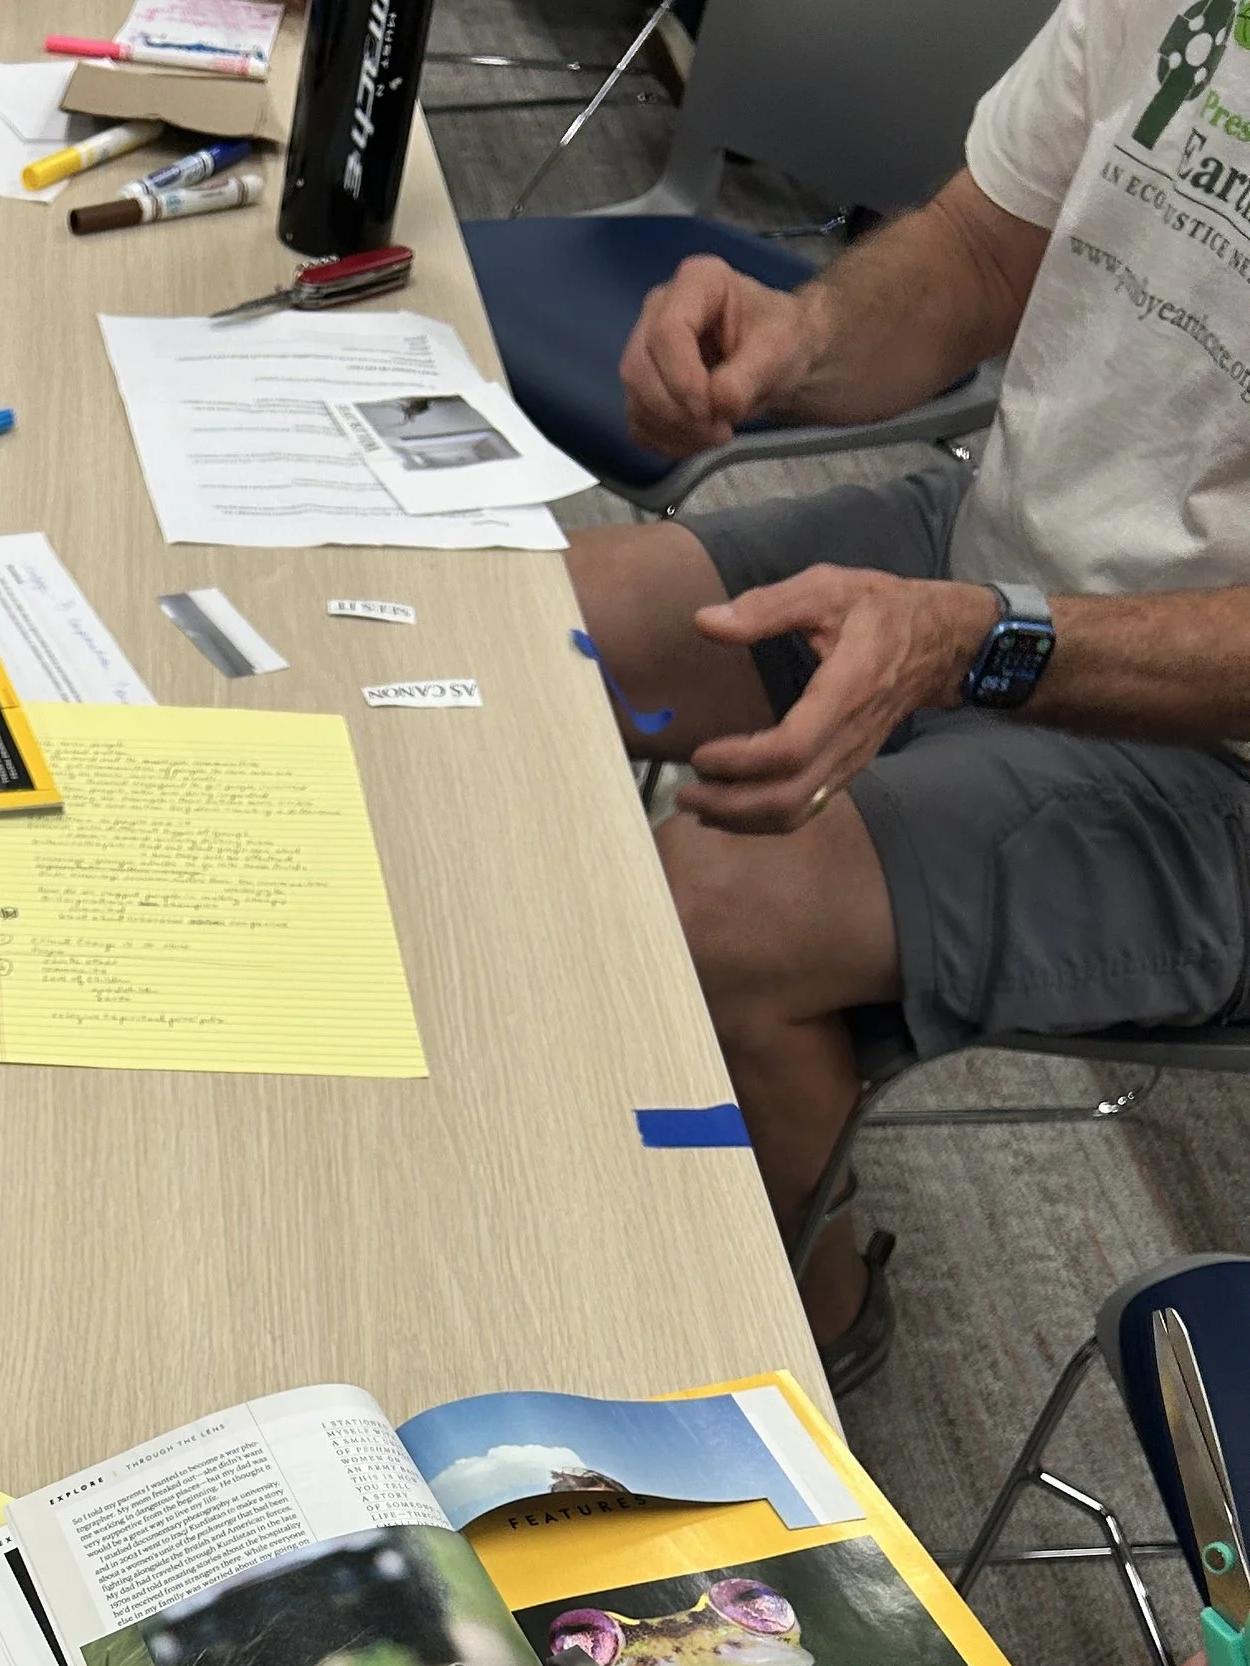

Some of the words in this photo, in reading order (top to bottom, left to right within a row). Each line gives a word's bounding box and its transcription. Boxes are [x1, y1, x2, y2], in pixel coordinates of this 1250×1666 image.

[1177, 127, 1250, 223] Eart
[368, 684, 447, 700] CANON
[449, 683, 478, 698] AS
[126, 1445, 174, 1471] THROUGH
[177, 1435, 197, 1446] THE
[200, 1424, 225, 1438] LENS
[49, 1477, 104, 1506] EXPLORE
[72, 1517, 83, 1526] So
[87, 1506, 104, 1519] told
[103, 1502, 116, 1511] my
[116, 1488, 146, 1507] parents
[150, 1471, 179, 1489] wanted
[187, 1456, 219, 1473] become
[224, 1447, 240, 1456] war
[373, 1491, 408, 1501] STORY
[507, 1494, 646, 1530] FEATURES
[106, 1591, 119, 1601] My
[120, 1582, 136, 1595] dad
[134, 1575, 152, 1588] had
[151, 1560, 184, 1580] traveled
[184, 1546, 217, 1565] through
[216, 1529, 257, 1550] Kurdistan
[256, 1524, 266, 1533] in
[266, 1520, 281, 1528] the
[280, 1514, 297, 1523] late
